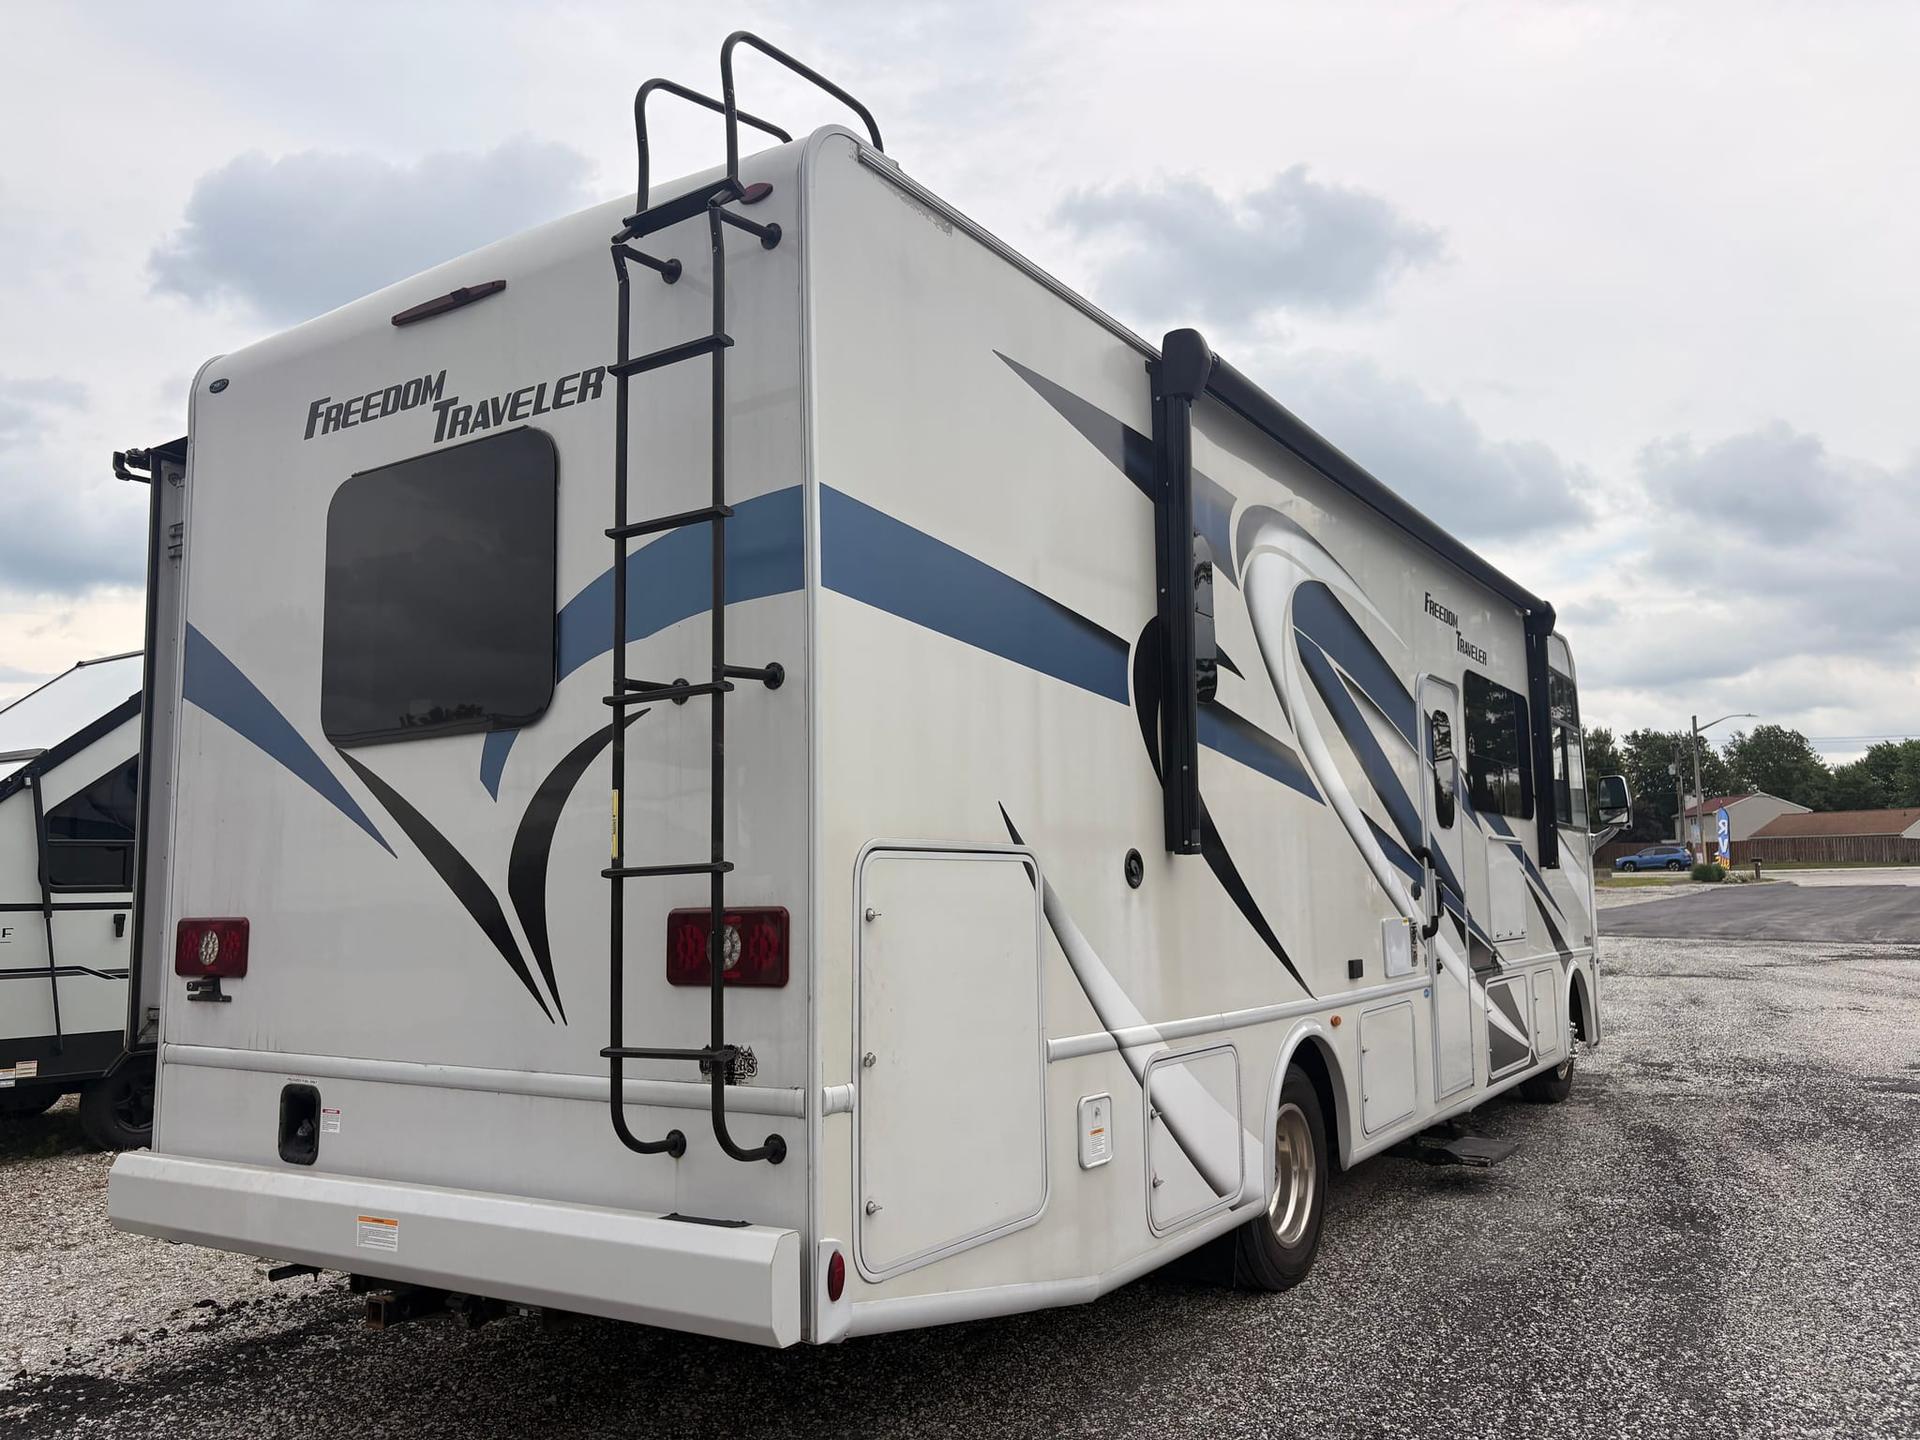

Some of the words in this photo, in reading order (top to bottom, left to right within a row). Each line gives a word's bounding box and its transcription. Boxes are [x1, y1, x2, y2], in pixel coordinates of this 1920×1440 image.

[304, 369, 447, 441] FREEDOM
[432, 366, 606, 443] TRAVELER
[1424, 591, 1459, 629] FREEDOM
[1456, 630, 1487, 666] TRAVELER
